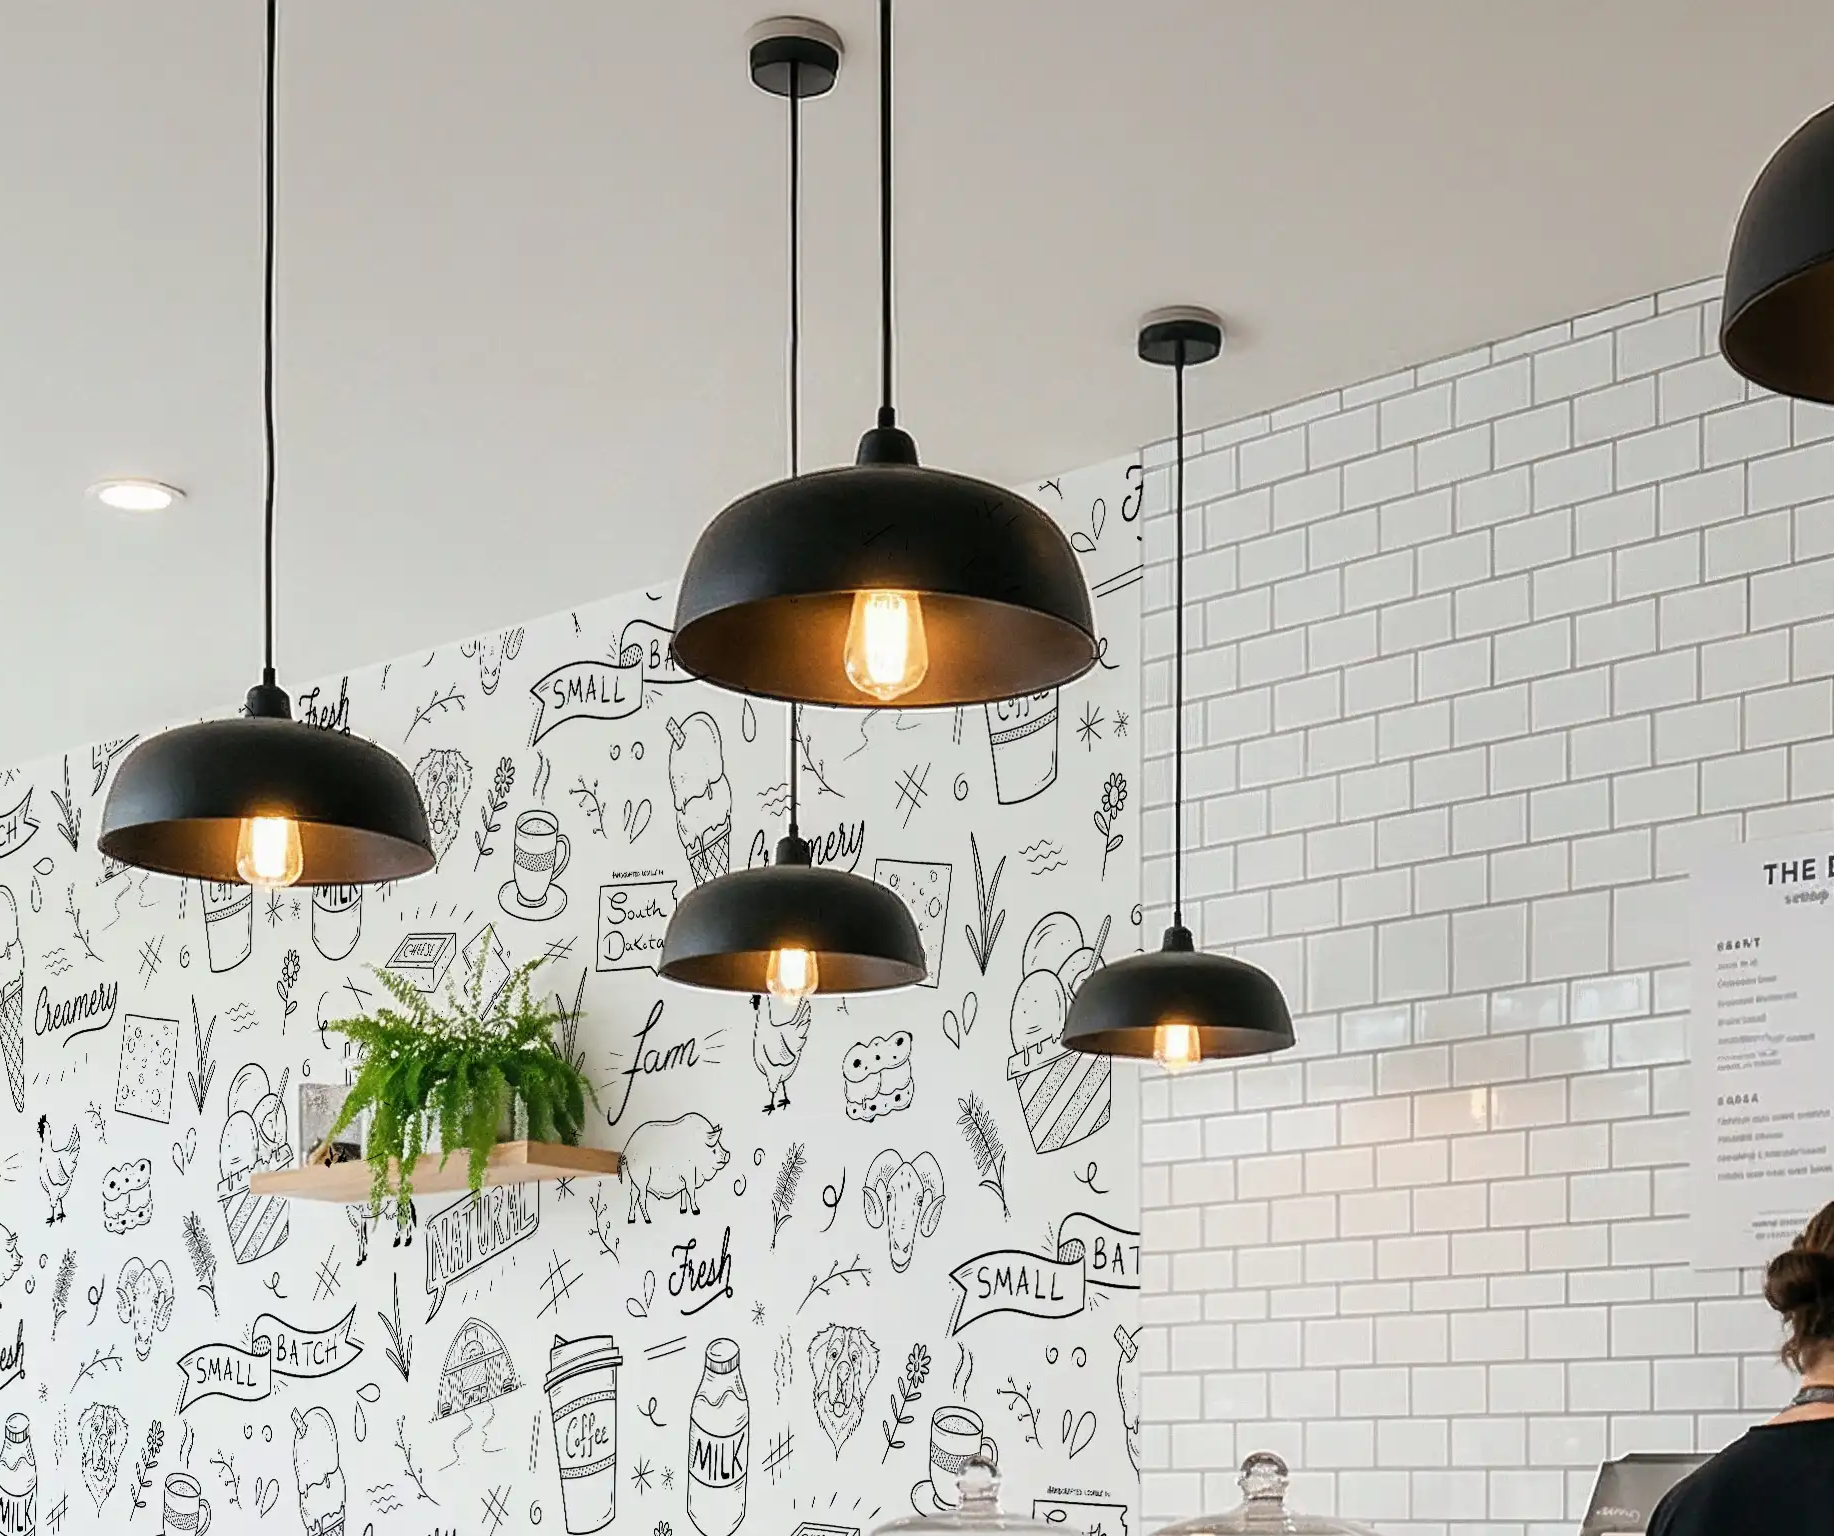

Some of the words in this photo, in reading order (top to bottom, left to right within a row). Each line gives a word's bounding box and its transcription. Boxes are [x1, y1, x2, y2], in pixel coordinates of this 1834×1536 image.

[298, 675, 350, 736] Fresh
[552, 674, 626, 710] SMALL
[1763, 858, 1815, 885] THE
[607, 891, 667, 925] South
[603, 930, 665, 961] Dakota
[34, 981, 118, 1048] Creamery
[431, 1182, 536, 1283] NATURAL
[668, 1227, 735, 1316] Fresh
[977, 1266, 1064, 1301] SMALL
[196, 1357, 257, 1387] SMALL
[276, 1330, 341, 1364] BATCH
[565, 1412, 609, 1459] Coffee
[692, 1431, 745, 1481] MILK
